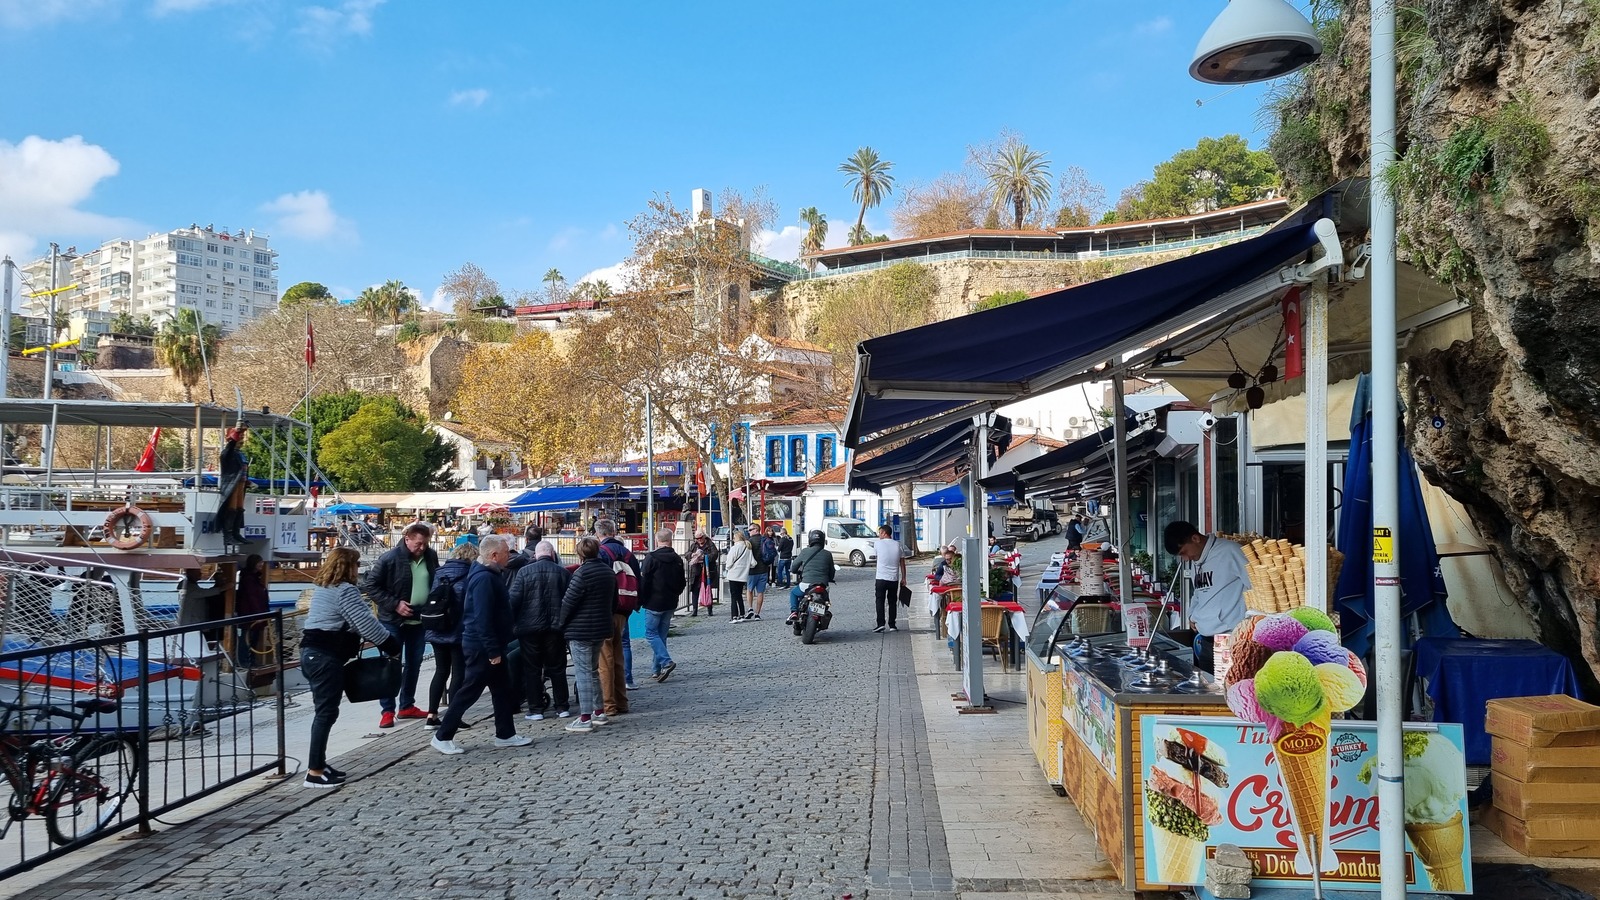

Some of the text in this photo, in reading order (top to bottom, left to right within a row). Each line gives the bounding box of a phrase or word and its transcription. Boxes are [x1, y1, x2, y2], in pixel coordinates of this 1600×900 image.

[281, 532, 297, 544] 174
[1283, 737, 1322, 749] MODA
[1335, 743, 1362, 752] TURKEY
